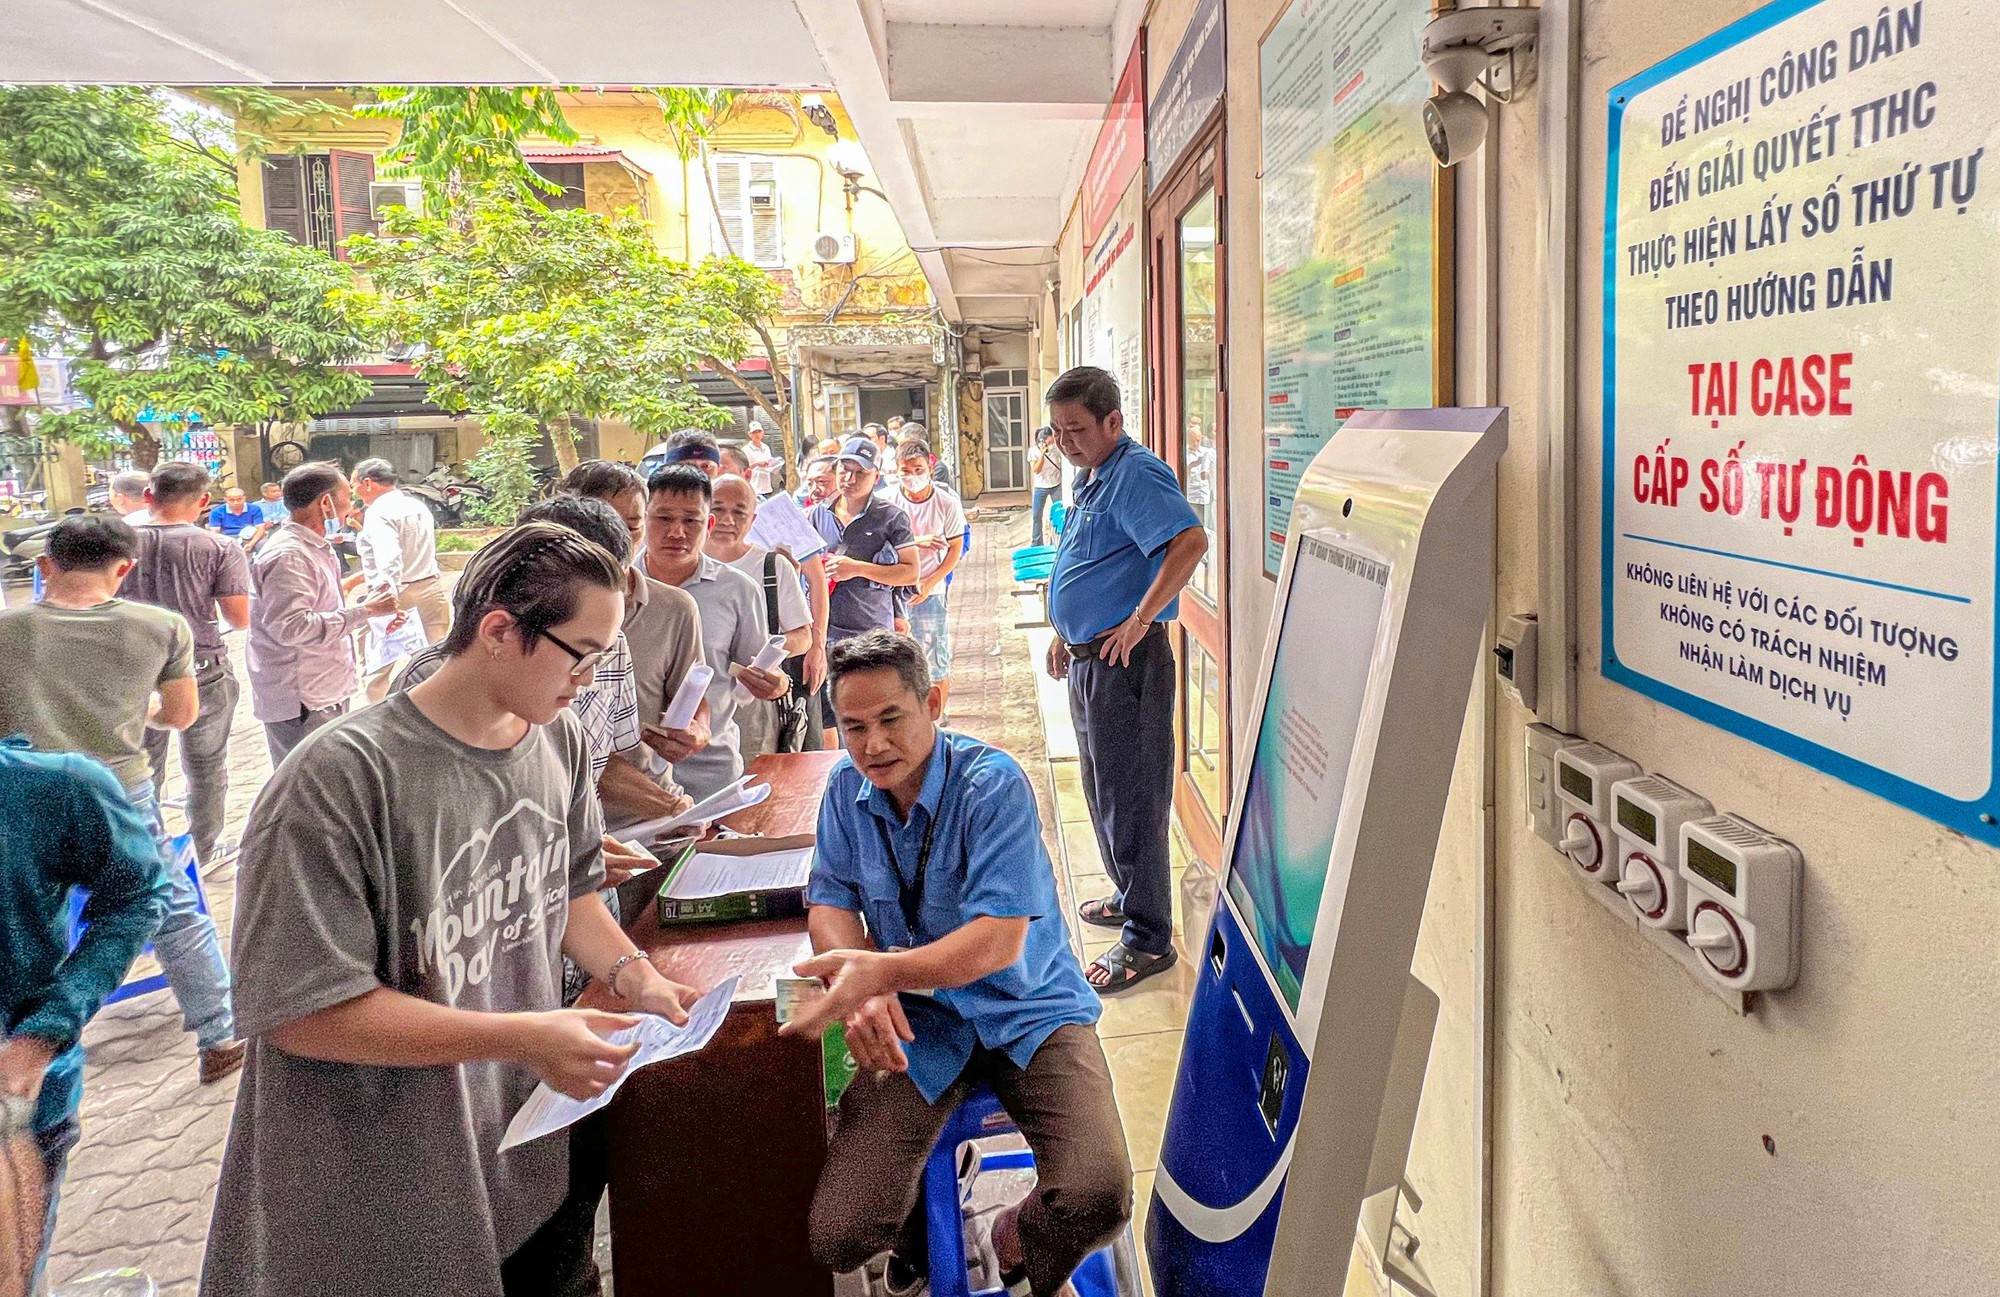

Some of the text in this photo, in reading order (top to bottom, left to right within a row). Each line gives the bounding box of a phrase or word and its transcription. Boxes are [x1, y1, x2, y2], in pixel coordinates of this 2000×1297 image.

[1661, 1, 1922, 148] ĐỀ NGHỊ CÔNG DÂN
[1649, 81, 1937, 213] ĐẾN GIẢI QUYẾT TTHC
[1628, 146, 1984, 279] THỰC HIỆN LẤY SỐ THỨ TỰ
[1665, 245, 1893, 330] THEO HƯỚNG DẪN
[1688, 352, 1854, 429] TẠI CASE
[1633, 437, 1949, 548] CẤP SỐ TỰ ĐỘNG
[1344, 554, 1358, 575] VẬN
[1626, 562, 1959, 662] KHÔNG LIÊN HỆ VỚI CÁC ĐỐI TƯỢNG
[1660, 602, 1886, 687] KHÔNG CÓ TRÁCH NHIỆM
[1679, 641, 1852, 723] NHẬN LÀM DỊCH VỤ
[502, 913, 528, 940] of
